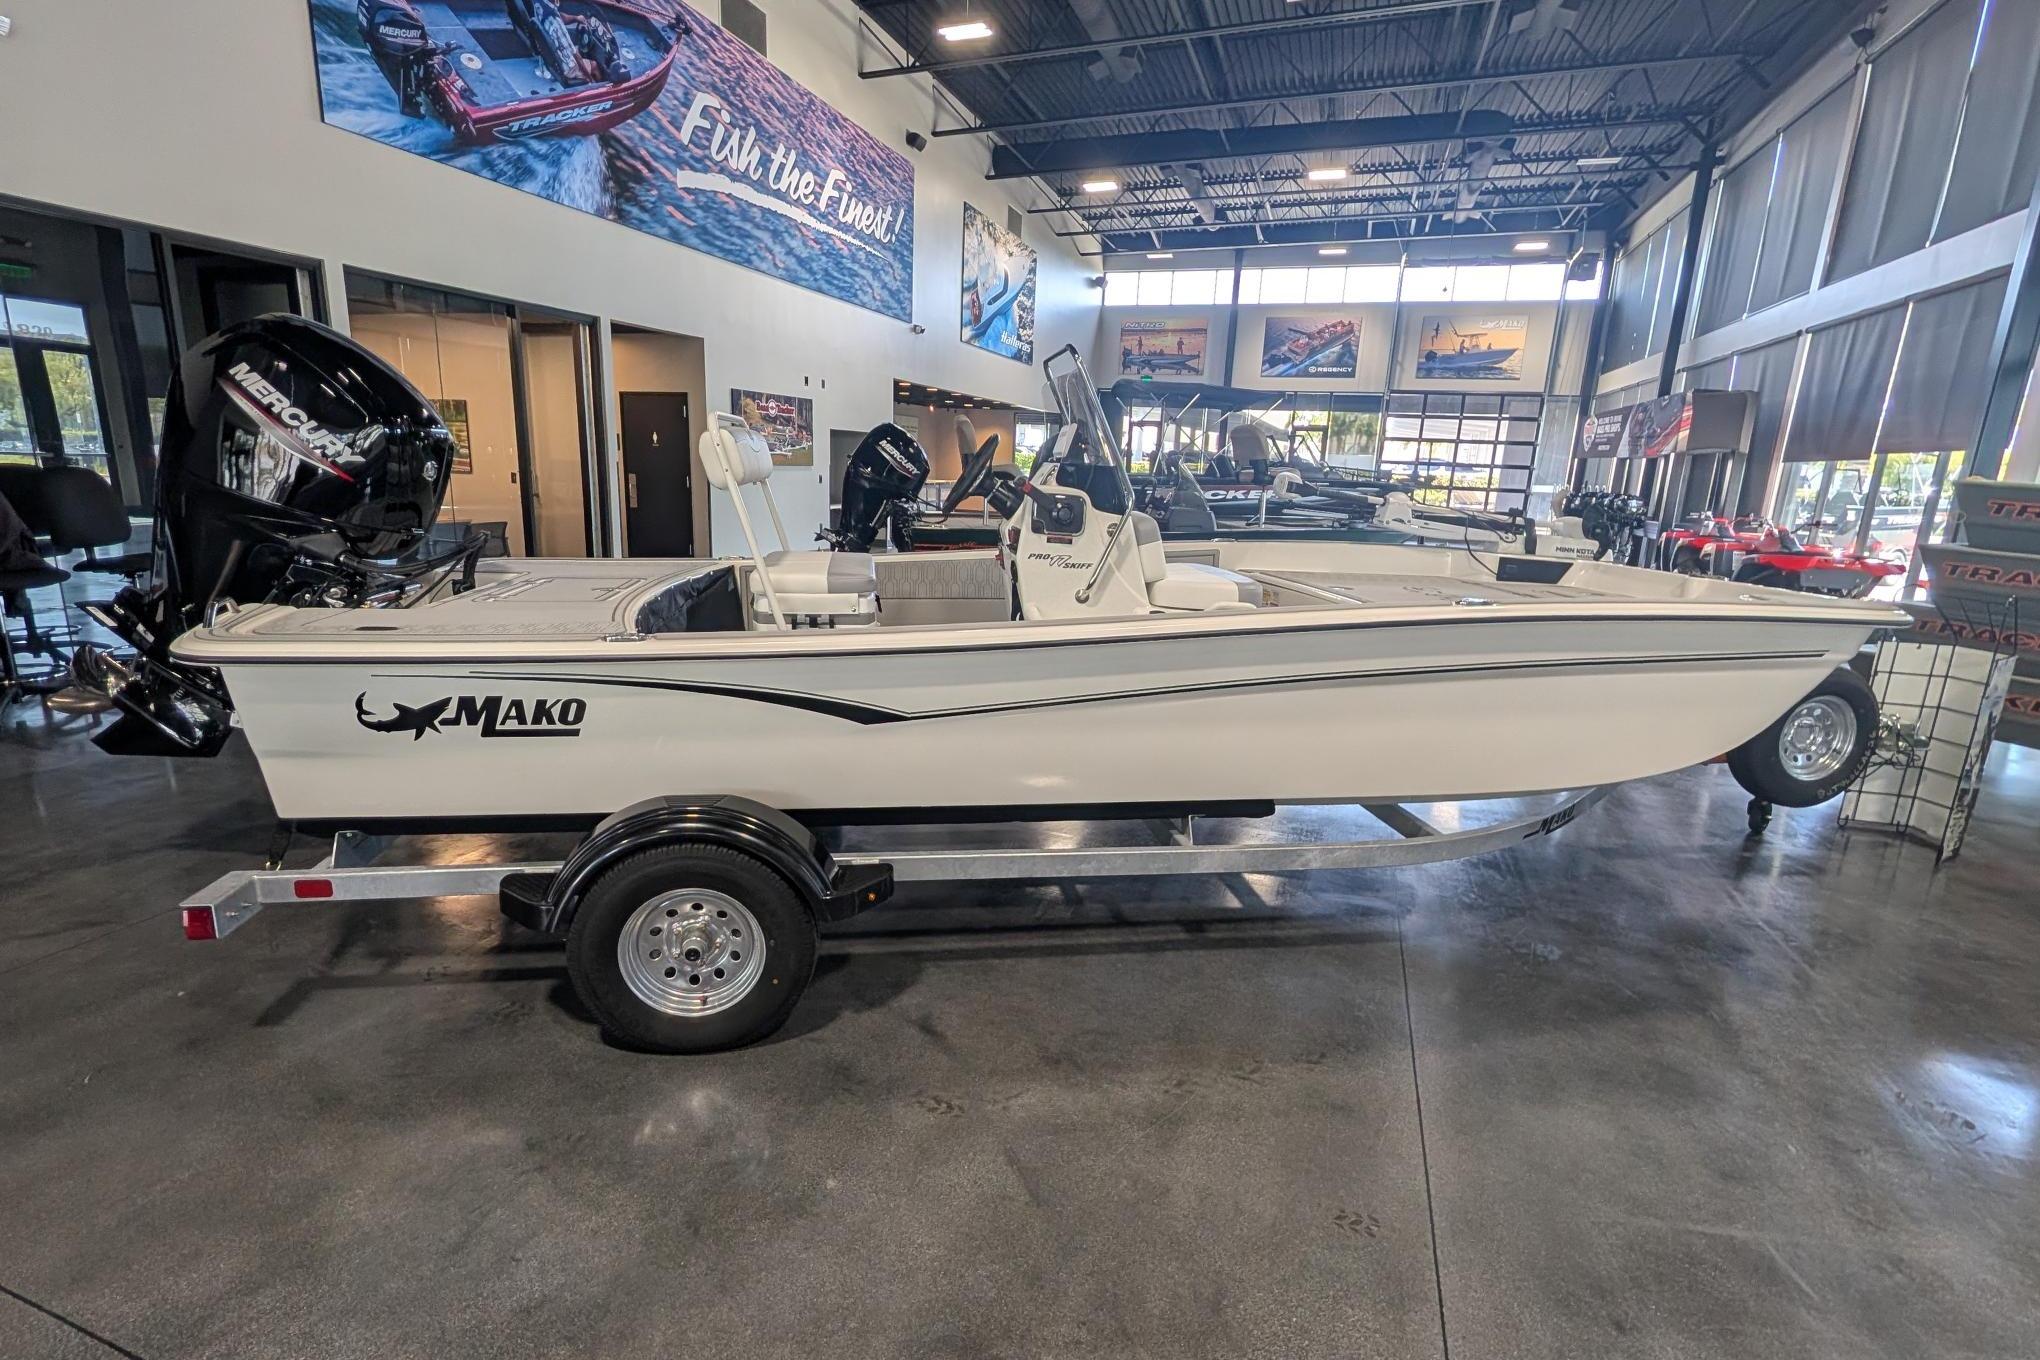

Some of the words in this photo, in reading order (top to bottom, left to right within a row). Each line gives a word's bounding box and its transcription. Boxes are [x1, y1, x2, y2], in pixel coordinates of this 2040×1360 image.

[380, 24, 422, 38] MERCURY
[508, 100, 614, 132] TRACKER
[680, 91, 763, 181] Fish
[768, 143, 815, 205] the
[819, 168, 905, 244] Finest!
[1123, 321, 1167, 329] NITRO
[228, 361, 367, 465] MERCURY
[878, 439, 921, 474] MERCURY
[1555, 546, 1575, 554] MINN
[1576, 547, 1595, 555] KOTA
[437, 695, 588, 737] MAKO
